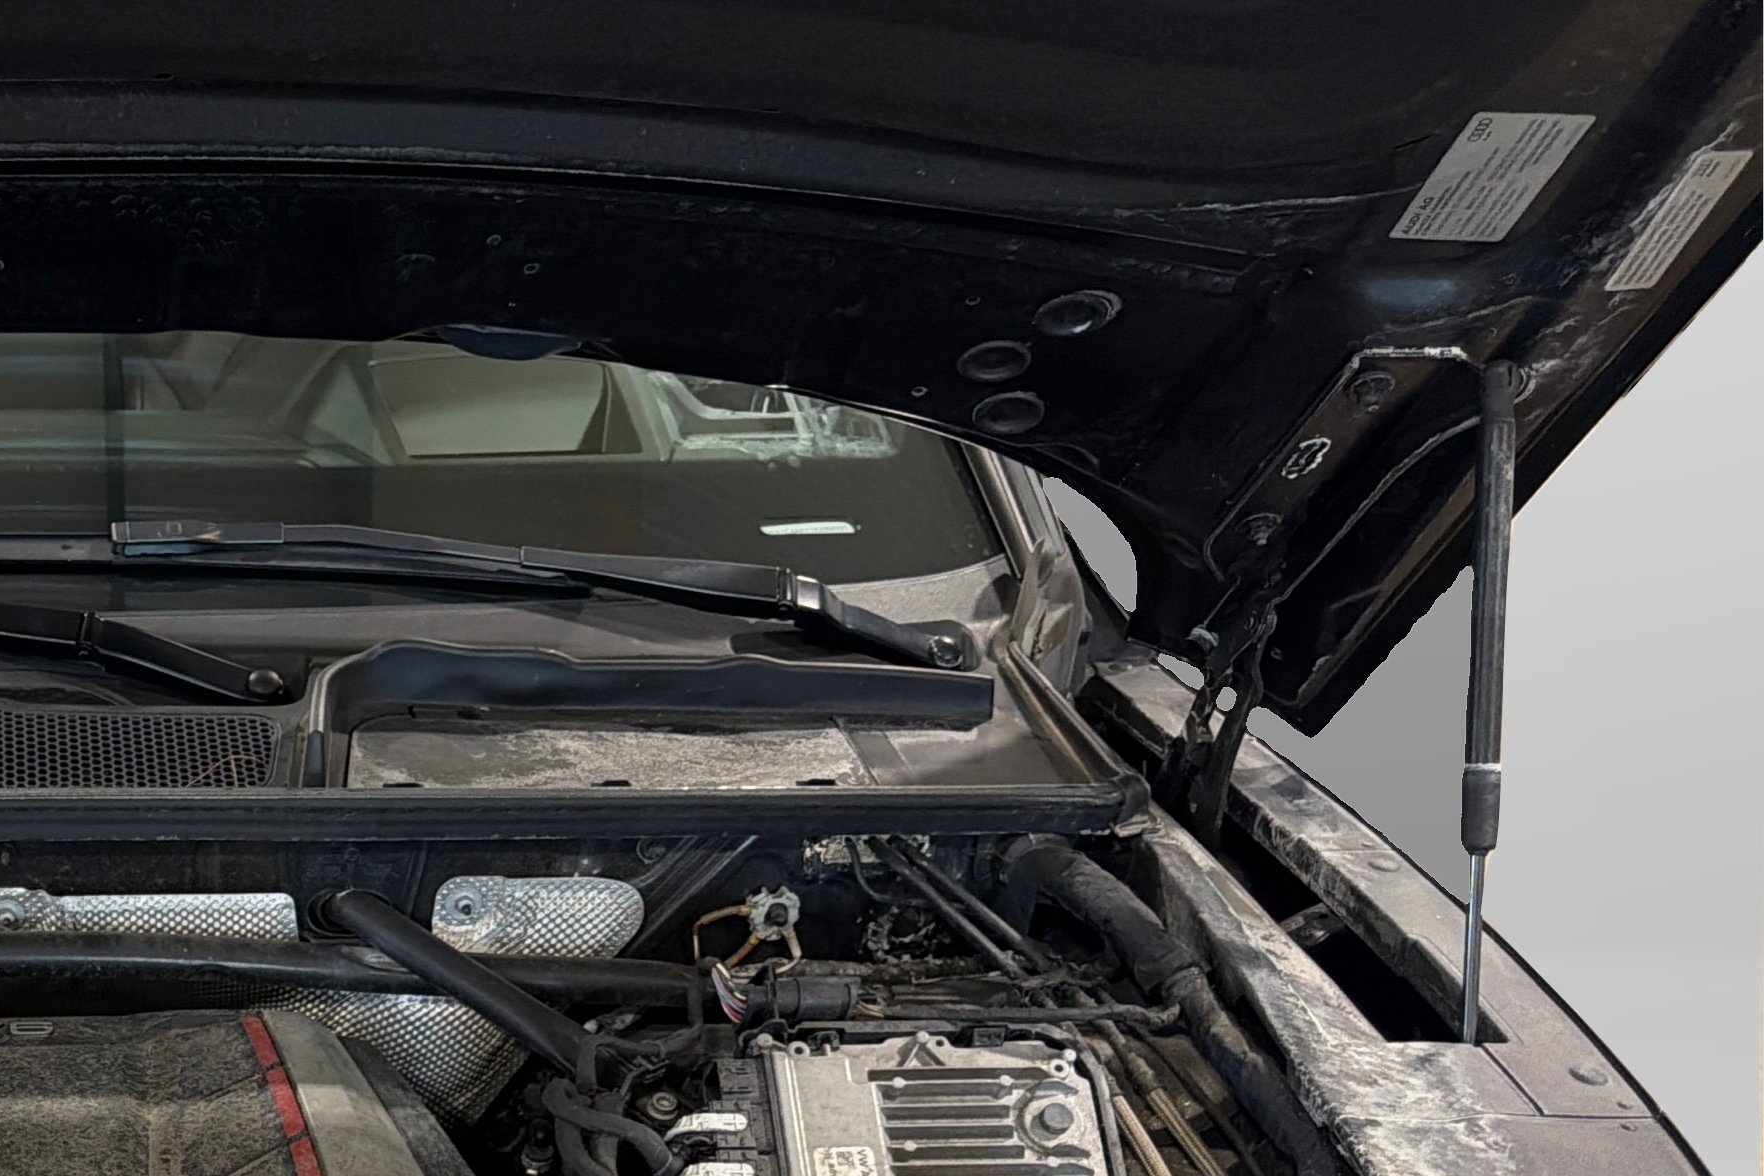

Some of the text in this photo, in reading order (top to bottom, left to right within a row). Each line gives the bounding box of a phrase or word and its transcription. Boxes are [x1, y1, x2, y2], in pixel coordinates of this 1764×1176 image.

[1402, 197, 1434, 234] AUDI AG
[857, 1149, 868, 1168] VW
